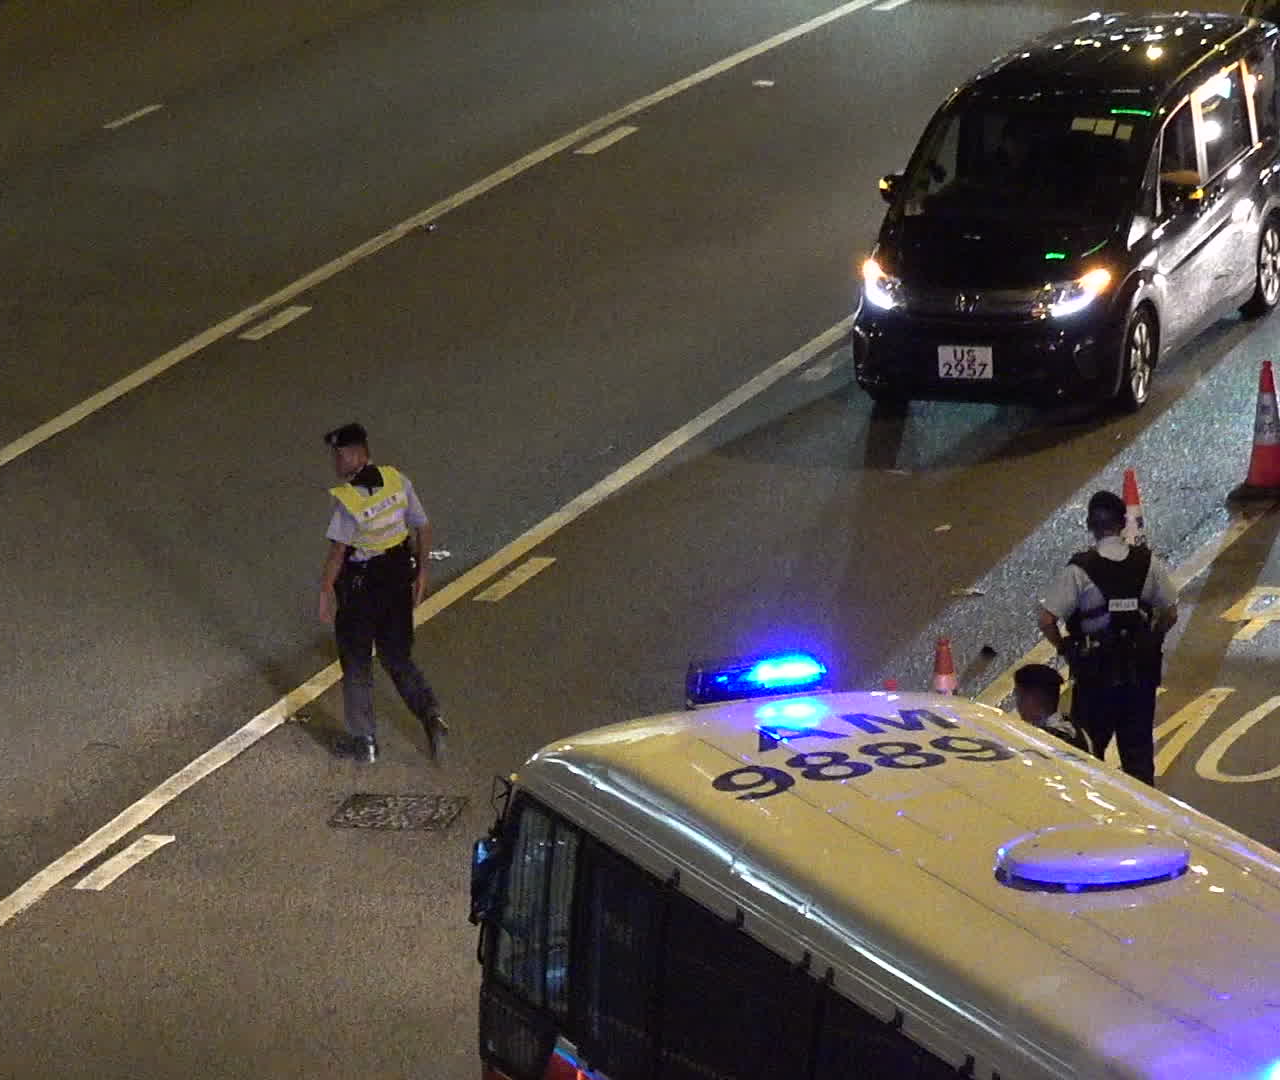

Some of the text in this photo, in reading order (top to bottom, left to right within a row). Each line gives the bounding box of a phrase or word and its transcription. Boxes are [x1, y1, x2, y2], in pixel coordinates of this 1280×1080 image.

[942, 361, 988, 377] 2957
[953, 348, 977, 362] US
[756, 708, 959, 753] AM
[711, 735, 1016, 801] 9889
